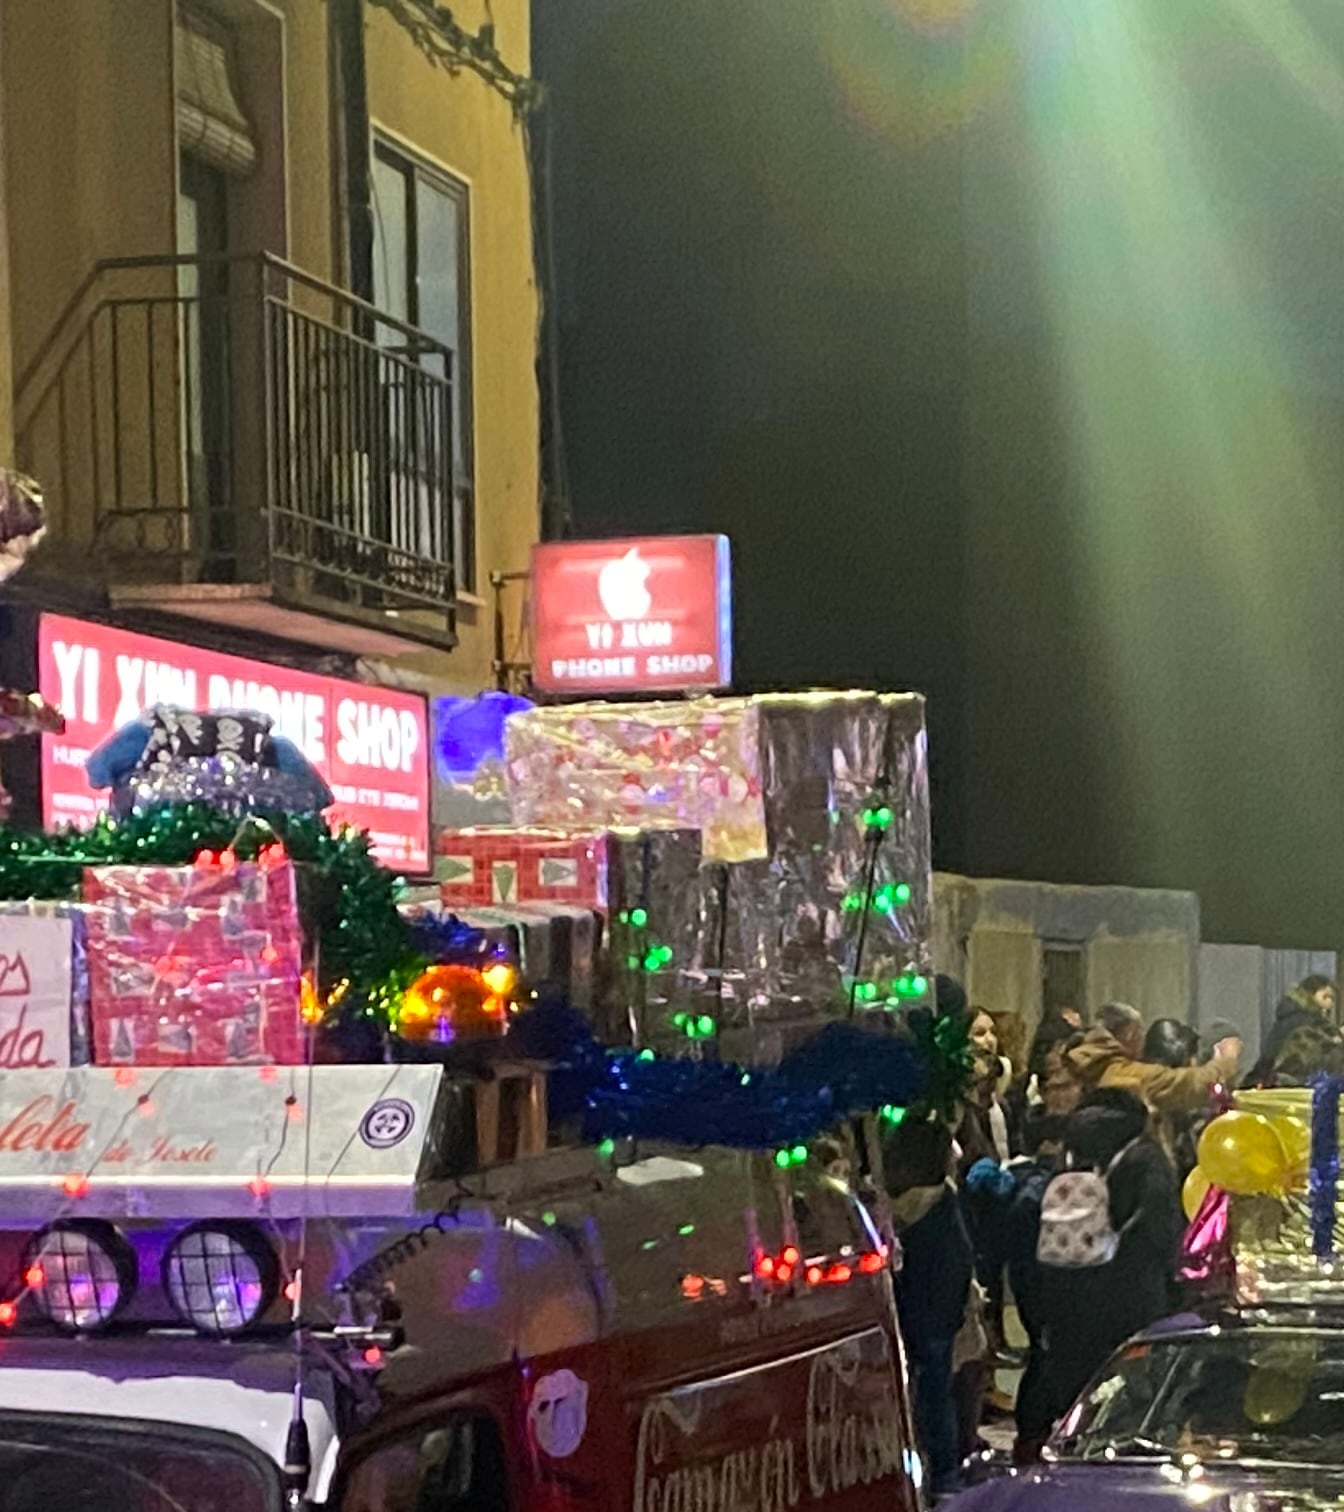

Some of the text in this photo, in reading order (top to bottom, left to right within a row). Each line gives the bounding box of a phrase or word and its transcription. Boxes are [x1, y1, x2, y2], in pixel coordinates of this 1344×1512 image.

[585, 620, 673, 650] YI XUN
[551, 652, 714, 679] PHONE SHOP
[53, 641, 99, 725] YI
[336, 696, 420, 774] SHOP
